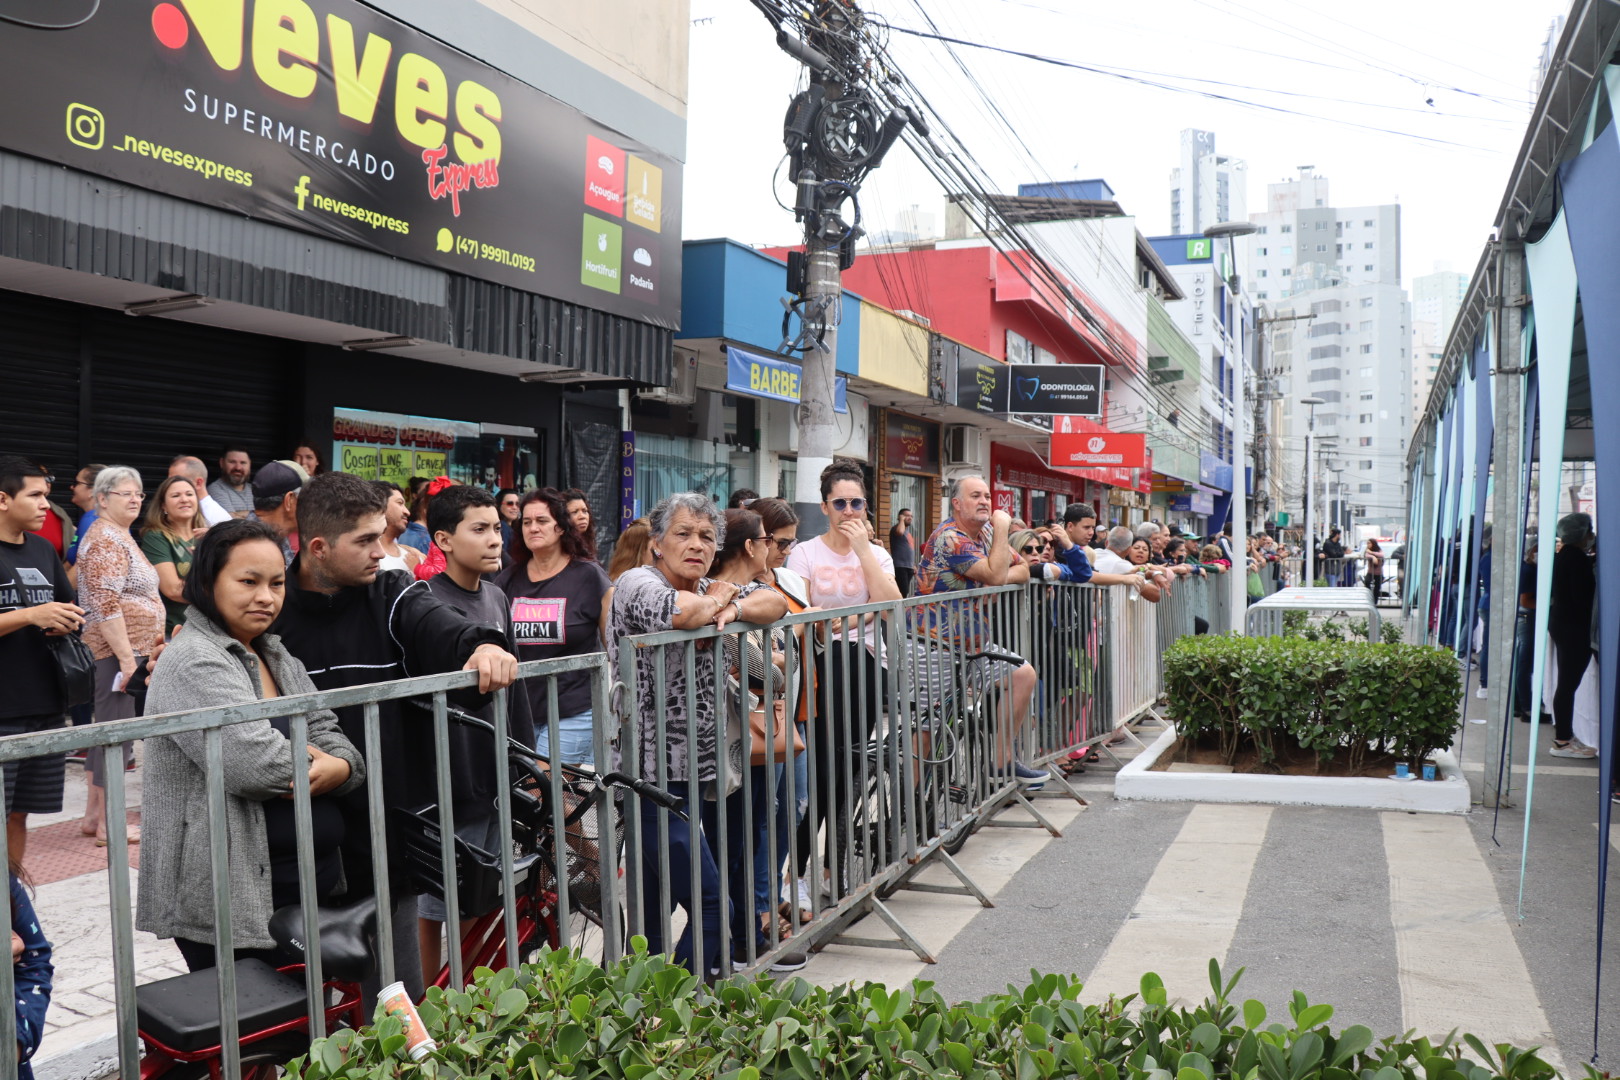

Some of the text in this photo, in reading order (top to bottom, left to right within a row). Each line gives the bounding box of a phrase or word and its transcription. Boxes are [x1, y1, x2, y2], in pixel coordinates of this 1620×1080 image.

[184, 88, 395, 181] SUPERMERCADO
[113, 135, 253, 187] _nevesexpress
[422, 144, 499, 217] Express
[589, 181, 620, 203] Açougue
[313, 193, 409, 234] nevesexpress
[456, 235, 536, 272] (47) 99911.0192
[585, 260, 618, 279] Hortifruti
[630, 274, 654, 291] Padaria
[1193, 272, 1205, 337] HOTEL
[750, 363, 802, 399] BARBE
[1041, 383, 1095, 392] ODONTOLOGIA
[333, 417, 455, 450] GRANDES OFERTAS
[622, 442, 634, 528] Barb
